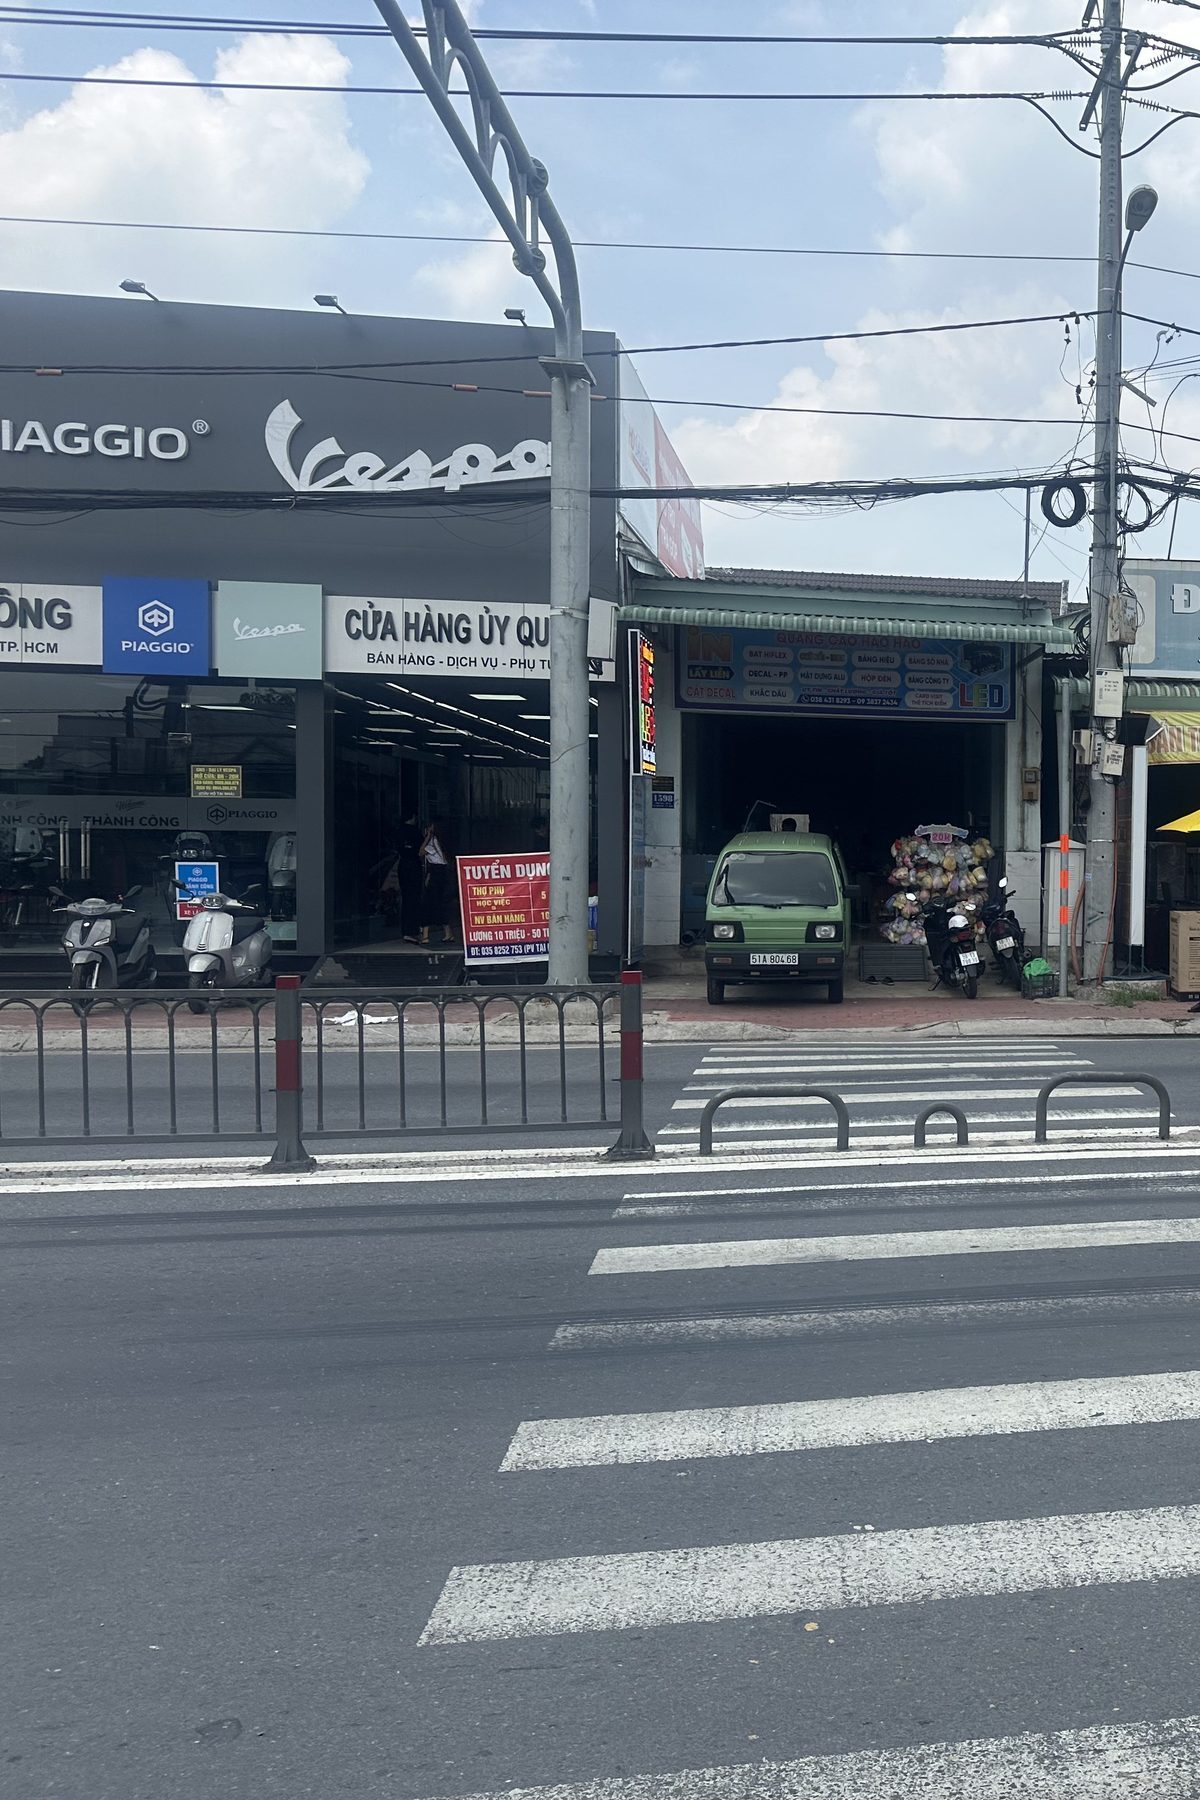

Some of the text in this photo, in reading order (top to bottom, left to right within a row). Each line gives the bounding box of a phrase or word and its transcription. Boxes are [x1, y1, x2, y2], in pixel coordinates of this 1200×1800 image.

[233, 617, 306, 640] Vespa
[345, 601, 550, 648] CỬA HÀNG ỦY QU
[24, 642, 58, 653] HCM
[121, 641, 190, 653] PIAGGIO
[367, 653, 394, 664] BÁN
[399, 652, 435, 667] HÀNG
[447, 656, 477, 669] DỊCH
[482, 657, 498, 670] VỤ
[510, 659, 536, 672] PHỤ
[749, 670, 772, 678] DECAL
[959, 682, 1004, 708] LED
[654, 794, 673, 802] 1598
[83, 812, 180, 828] THÀNH CÔNG
[228, 810, 278, 819] PIAGGIO
[463, 859, 550, 881] TUYỂN DỤN
[472, 886, 546, 899] THỢ PHỤ 5
[493, 899, 510, 907] VIỆC
[474, 917, 485, 925] NV
[486, 915, 502, 924] BÁN
[504, 914, 525, 923] HÀNG
[494, 931, 503, 940] 10
[505, 929, 526, 942] TRIỆU
[532, 930, 541, 939] 50
[482, 947, 493, 955] 035
[494, 946, 510, 955] 8252
[511, 946, 523, 954] 753
[752, 955, 767, 964] 51A
